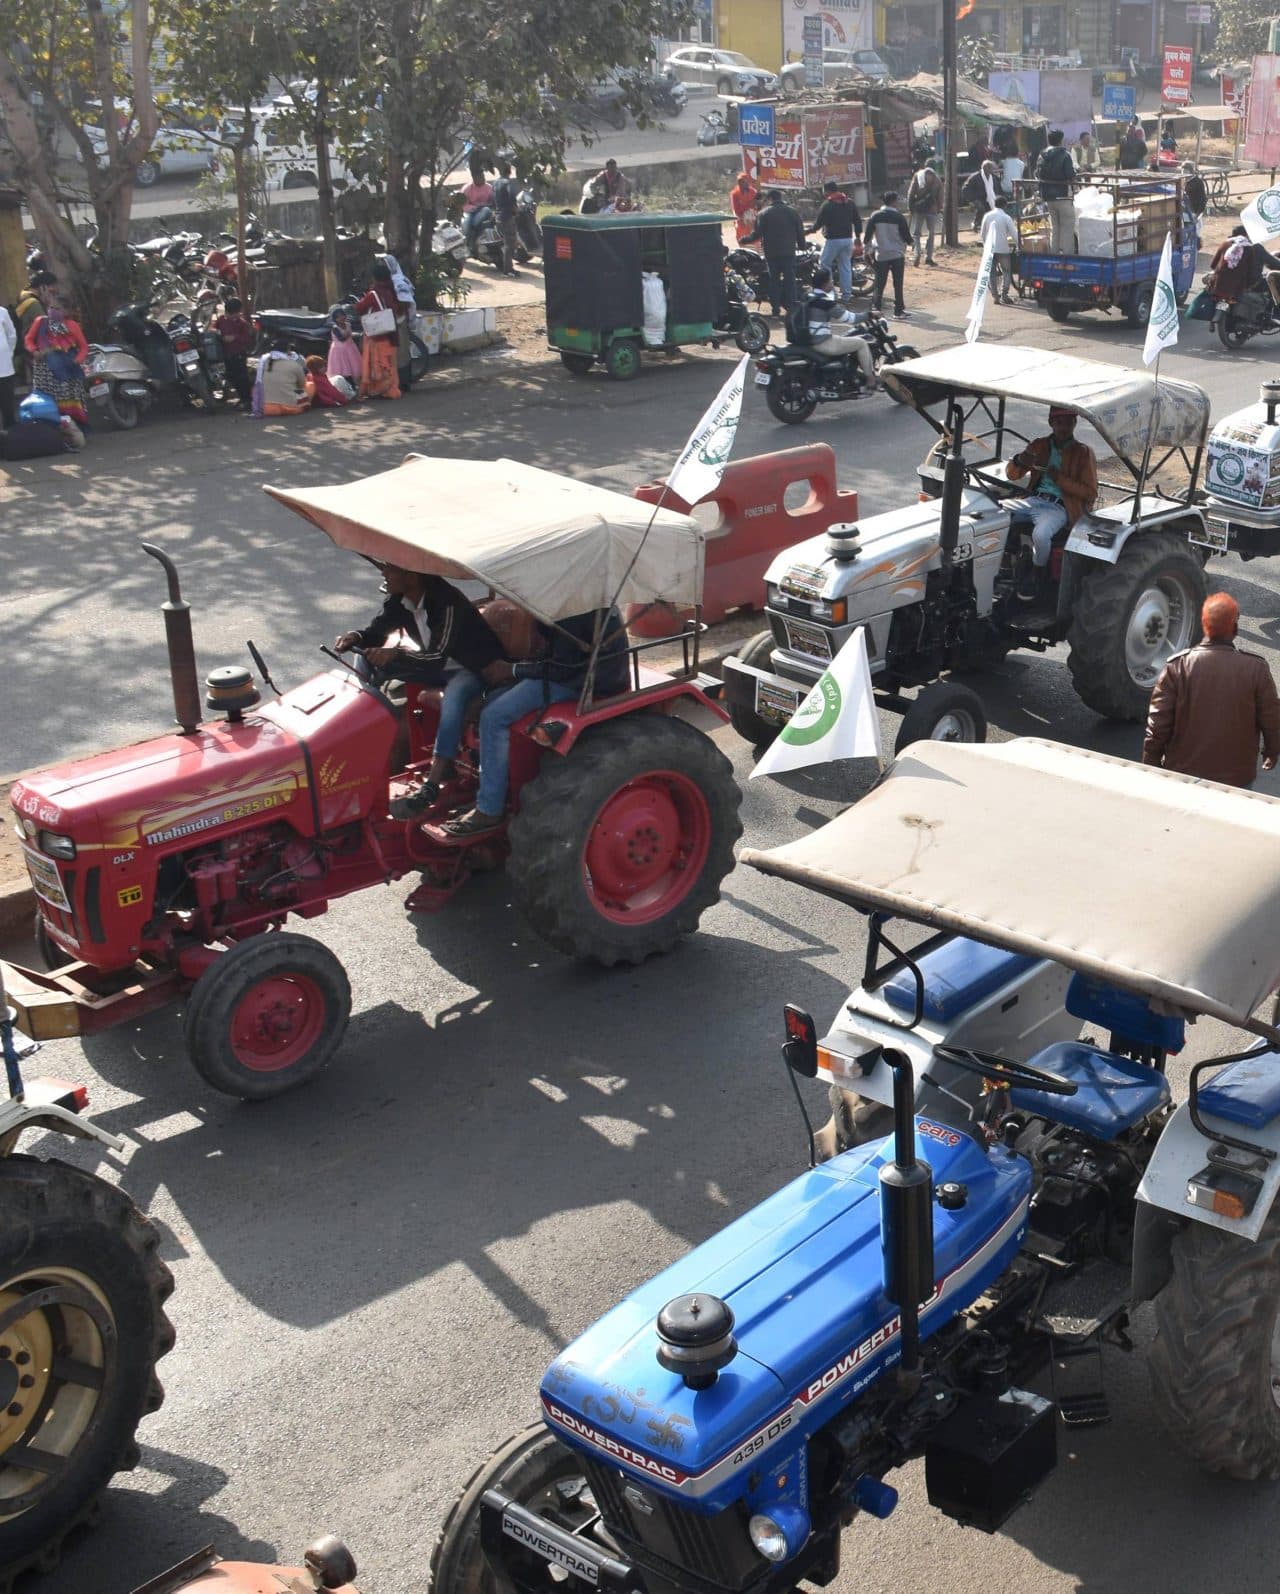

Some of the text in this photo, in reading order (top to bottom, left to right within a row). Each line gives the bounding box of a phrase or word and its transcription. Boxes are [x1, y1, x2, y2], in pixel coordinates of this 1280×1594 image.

[742, 115, 770, 136] प्रवेश
[147, 815, 221, 845] Mahindra
[113, 851, 136, 866] DLX
[918, 1121, 962, 1146] care
[853, 1366, 881, 1394] Super
[550, 1405, 678, 1481] POWERTRAC
[733, 1436, 765, 1466] 439
[767, 1414, 792, 1440] DS
[503, 1518, 598, 1580] POWERTRAC
